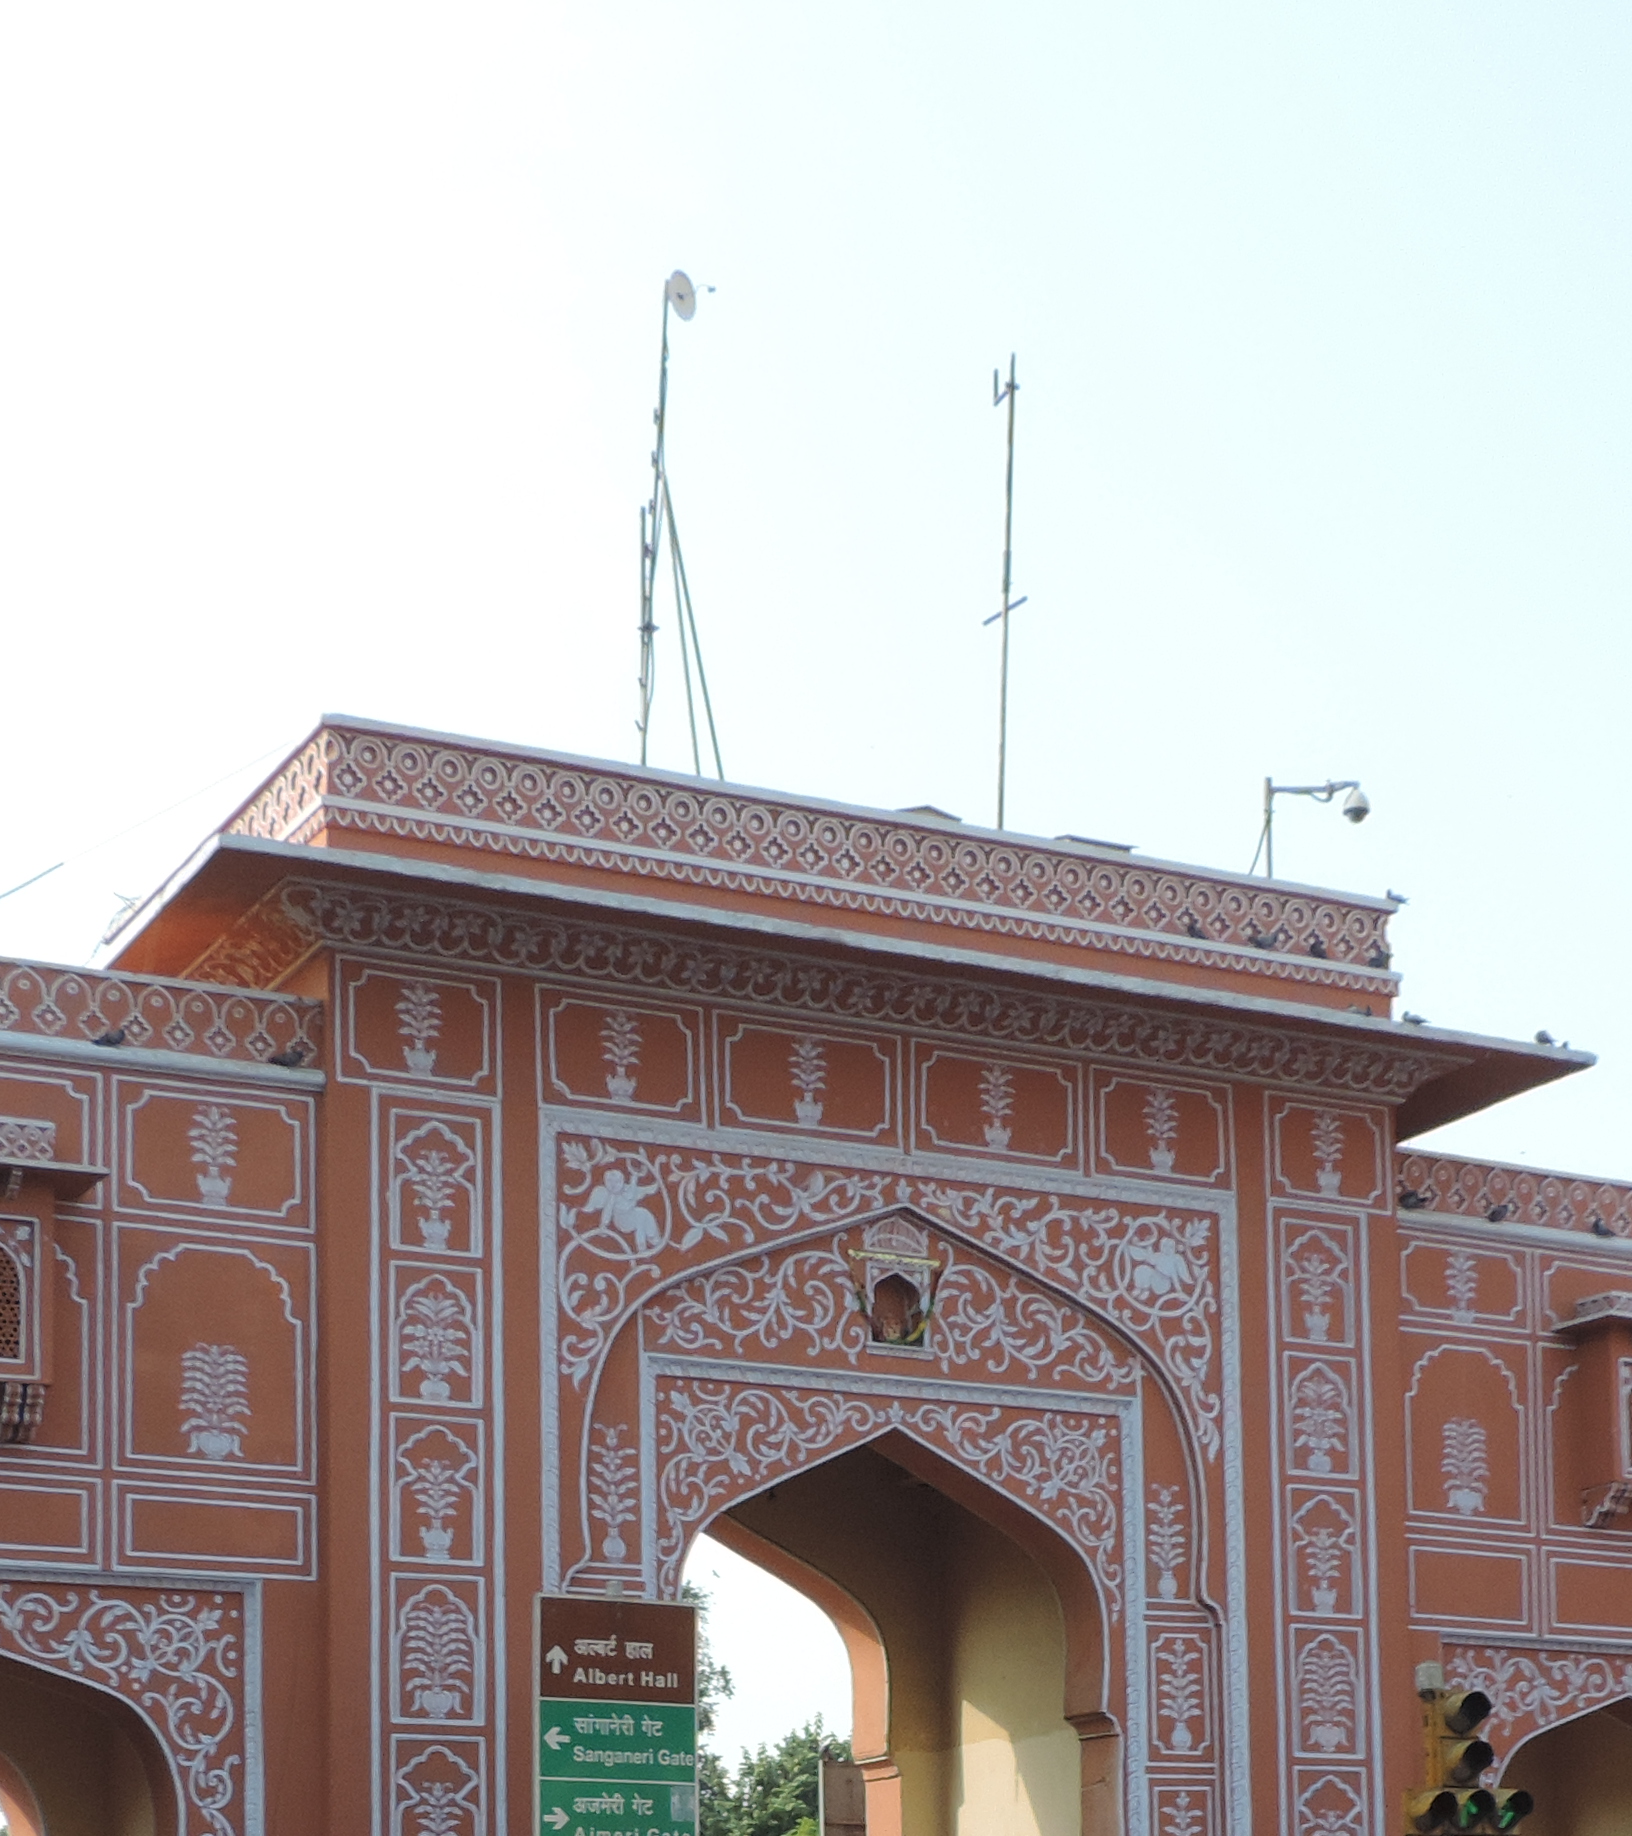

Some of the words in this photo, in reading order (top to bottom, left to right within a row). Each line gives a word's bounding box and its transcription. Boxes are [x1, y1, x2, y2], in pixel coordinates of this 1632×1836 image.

[574, 1635, 618, 1657] अल्बर्ट
[624, 1641, 654, 1660] हाल
[573, 1667, 635, 1687] Albert
[640, 1670, 679, 1689] Hall
[573, 1713, 635, 1736] सांगानेरी
[640, 1714, 664, 1737] गेट
[573, 1745, 654, 1767] Sanganeri
[658, 1749, 694, 1766] Gate
[572, 1792, 625, 1815] अजमेरी
[631, 1793, 654, 1816] गेट
